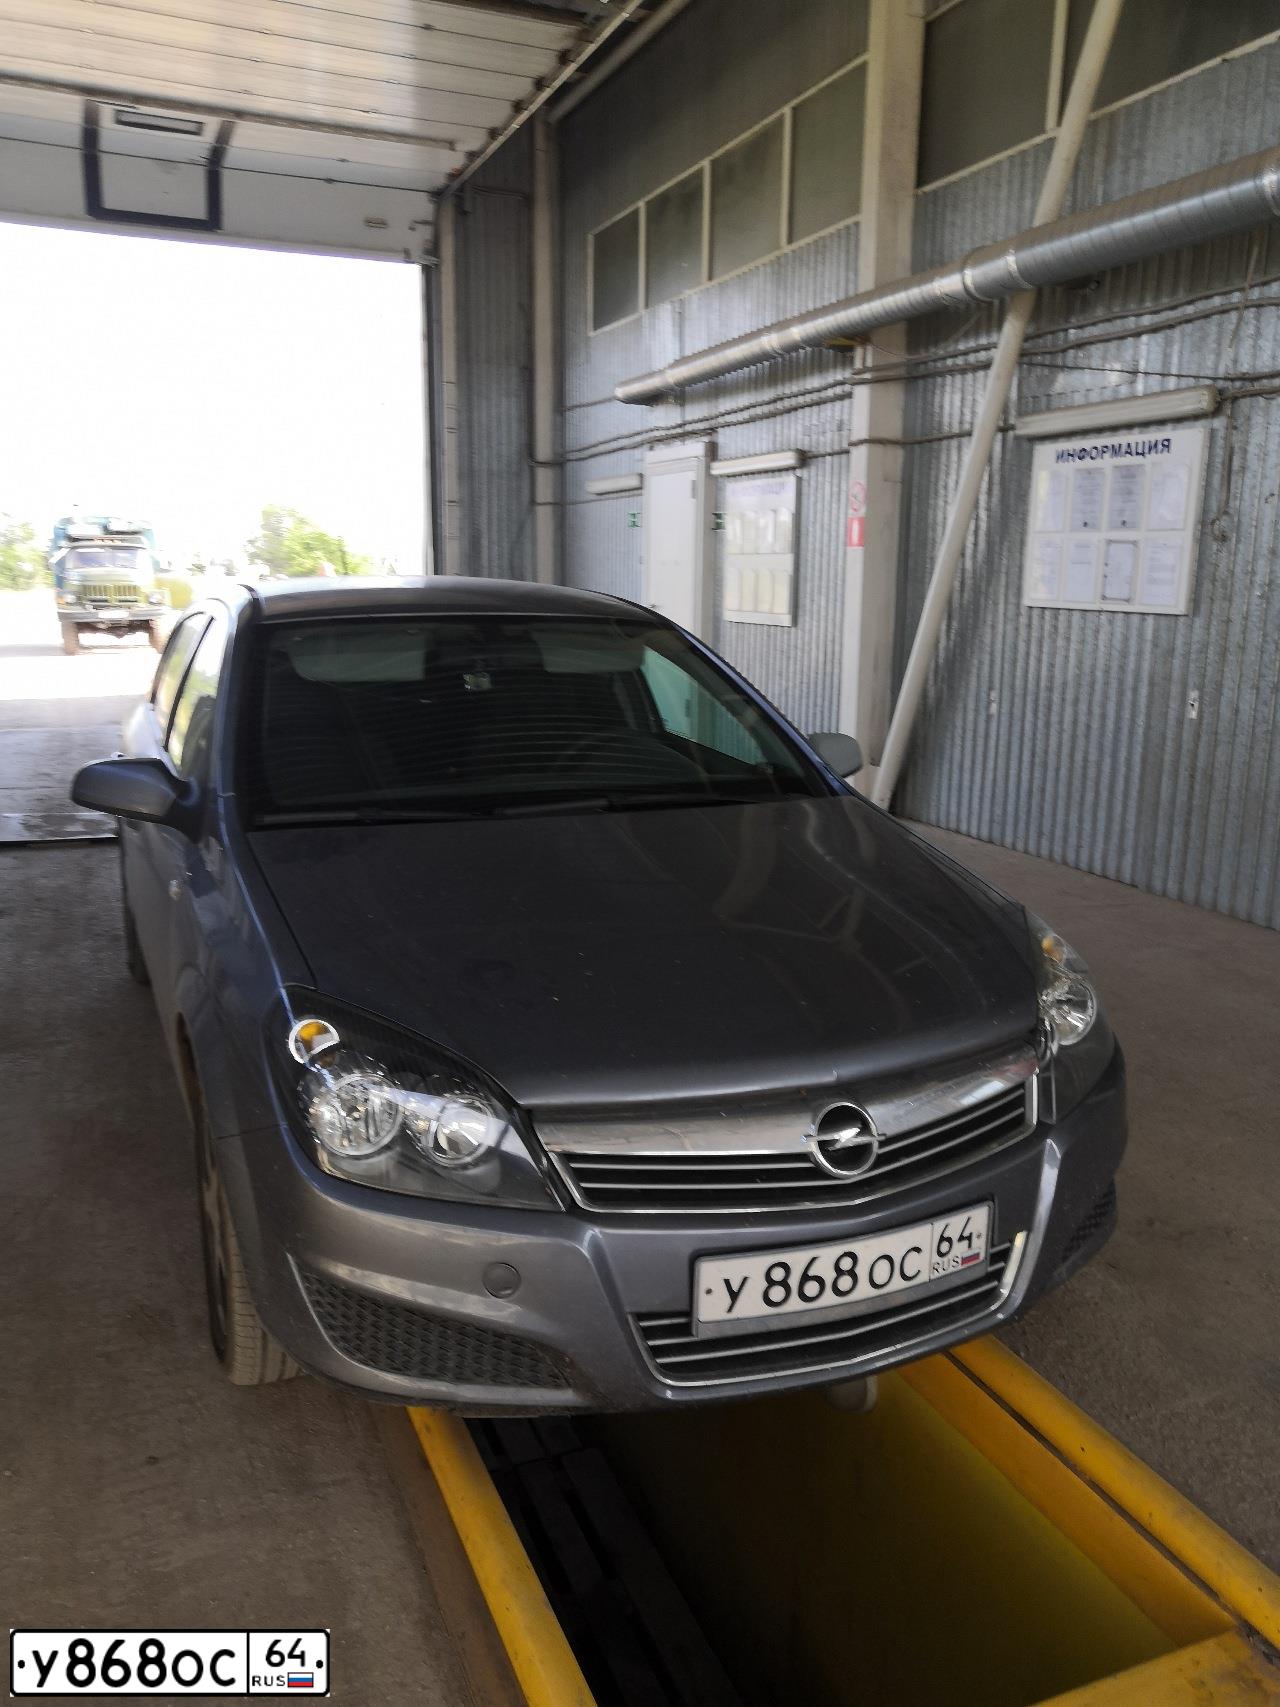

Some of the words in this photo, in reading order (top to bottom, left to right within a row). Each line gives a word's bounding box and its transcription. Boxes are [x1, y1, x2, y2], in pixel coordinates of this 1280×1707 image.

[1055, 438, 1172, 463] ИНФОРМАЦИЯ
[936, 1216, 974, 1258] 64
[932, 1254, 960, 1275] RUS
